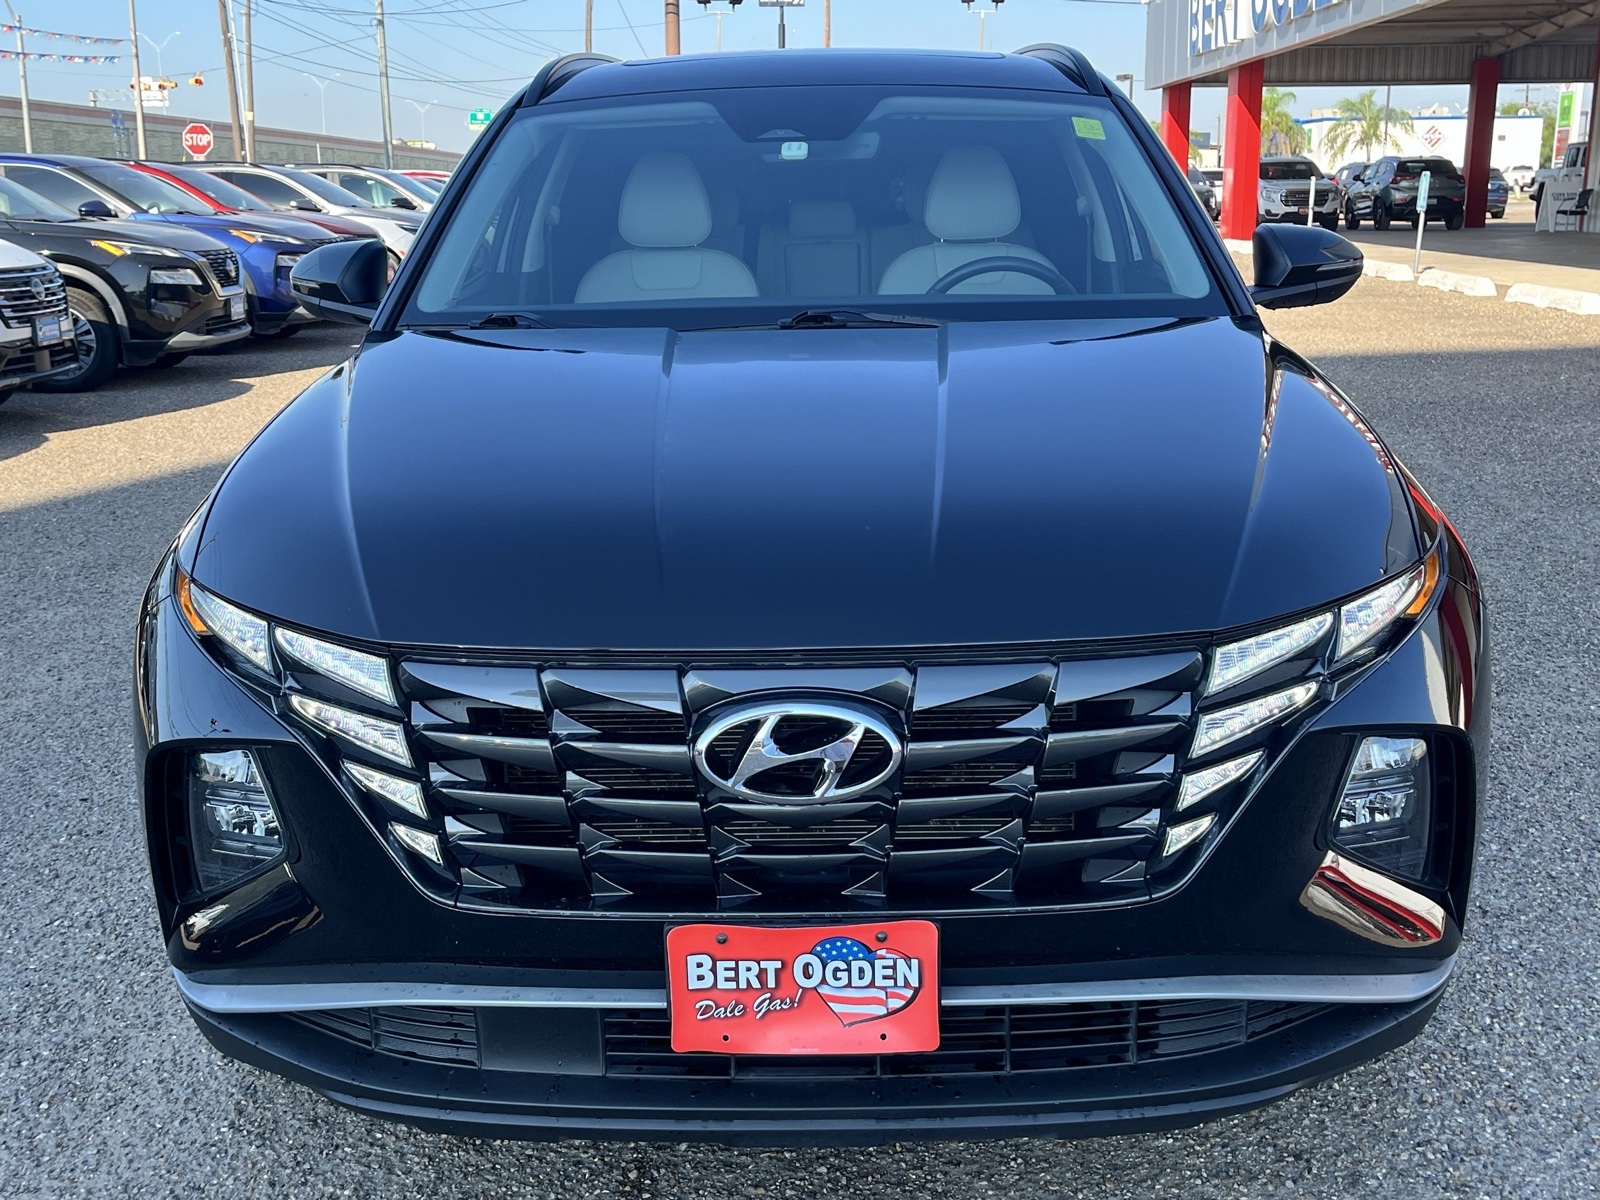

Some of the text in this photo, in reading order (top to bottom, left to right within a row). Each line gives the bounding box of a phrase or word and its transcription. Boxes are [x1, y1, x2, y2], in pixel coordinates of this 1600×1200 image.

[185, 133, 210, 146] STOP
[686, 952, 920, 990] BERT OGDEN
[695, 988, 803, 1020] Dale Gas!
